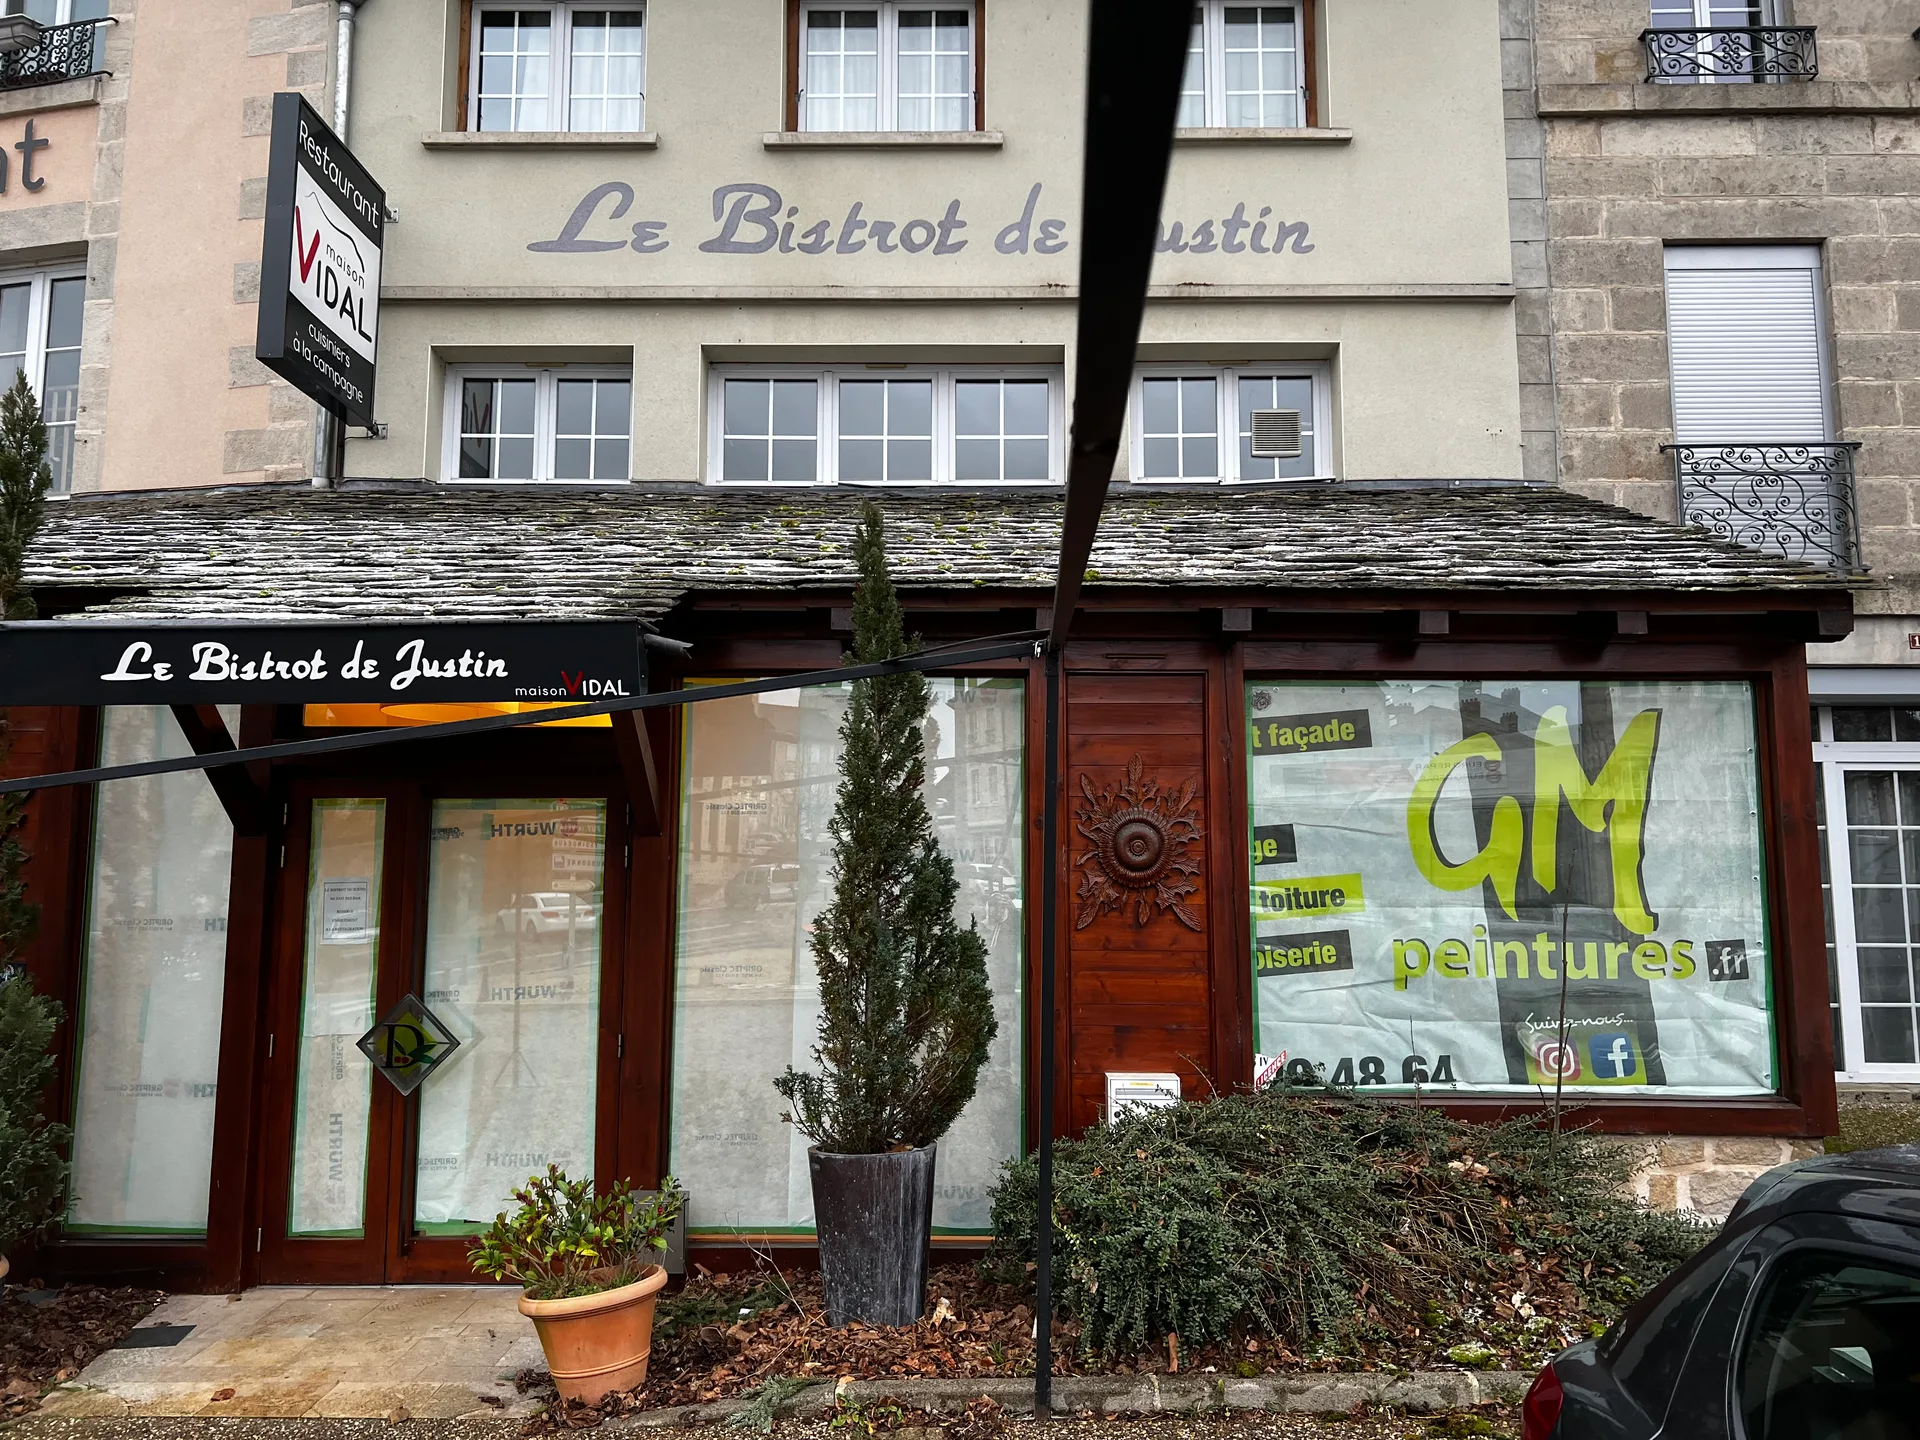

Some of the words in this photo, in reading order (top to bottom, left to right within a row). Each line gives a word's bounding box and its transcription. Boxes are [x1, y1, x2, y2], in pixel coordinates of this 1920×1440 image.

[299, 119, 379, 230] Restaurant
[526, 181, 670, 254] Le
[698, 182, 968, 255] Bistrot
[993, 182, 1069, 255] de
[1153, 201, 1316, 254] ustin
[295, 205, 373, 344] VIDAL
[325, 243, 366, 290] maison
[292, 331, 301, 352] à
[302, 344, 312, 364] la
[313, 355, 363, 404] campagne
[308, 321, 351, 368] cuisiniers
[100, 641, 174, 681] Le
[188, 641, 328, 681] Bistrot
[341, 639, 380, 680] de
[390, 639, 509, 691] Justin
[515, 686, 567, 696] maison
[561, 670, 630, 696] VIDAL
[1267, 718, 1356, 751] façade
[1407, 704, 1663, 935] GM
[1258, 886, 1345, 914] toiture
[1391, 924, 1697, 992] peintures
[1711, 946, 1749, 977] .fr
[1256, 1050, 1287, 1088] LICENCE
[1259, 1056, 1269, 1067] IV
[1330, 1056, 1387, 1086] 48
[1401, 1054, 1458, 1084] 64
